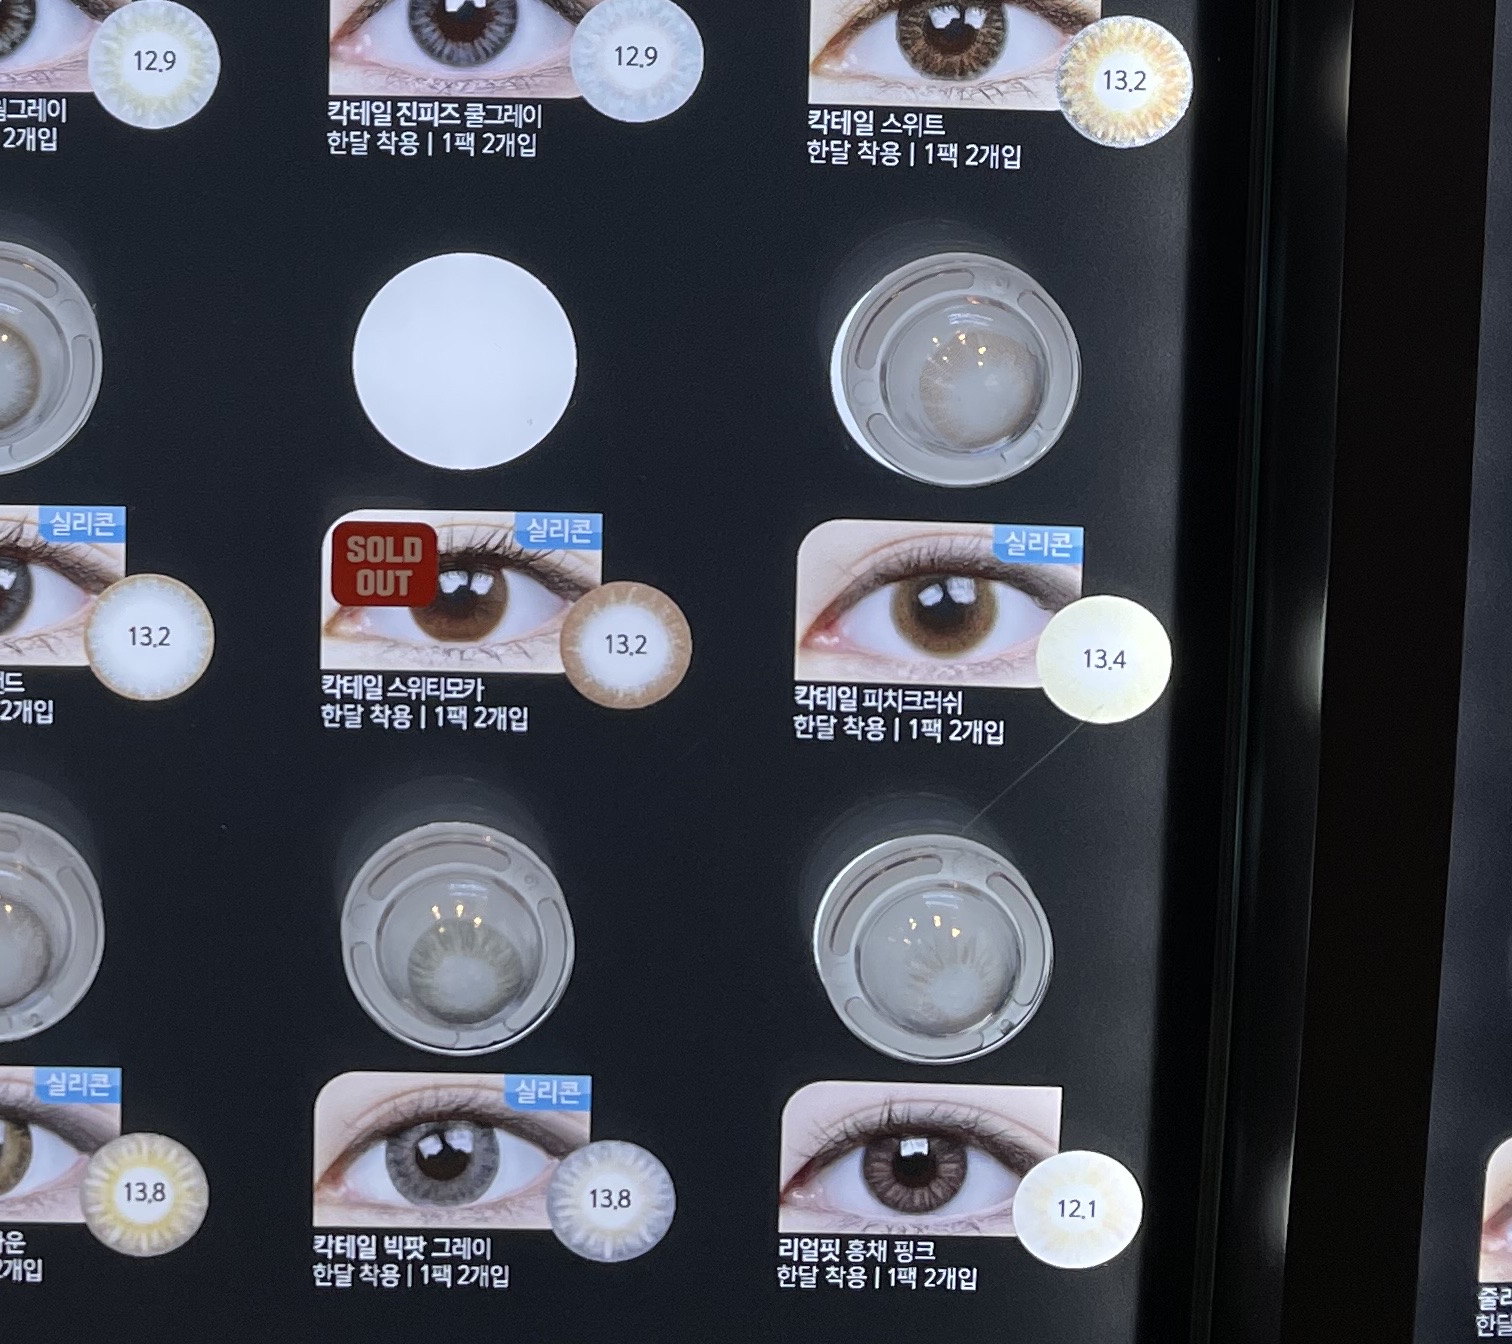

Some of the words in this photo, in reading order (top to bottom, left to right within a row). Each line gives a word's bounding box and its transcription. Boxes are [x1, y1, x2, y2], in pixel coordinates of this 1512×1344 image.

[134, 50, 176, 73] 12.9
[615, 46, 658, 68] 12.9
[1103, 70, 1147, 93] 13.2
[328, 101, 392, 127] 칵테일
[396, 102, 461, 127] 진피즈
[464, 103, 542, 129] 쿨그레이
[808, 110, 874, 137] 칵테일
[880, 112, 945, 138] 스위트
[807, 140, 850, 166] 한달
[857, 141, 901, 167] 착용
[925, 143, 958, 168] 1팩
[965, 144, 1022, 170] 2개입
[50, 511, 116, 537] 실리콘
[527, 518, 592, 544] 실리콘
[347, 536, 422, 563] SOLD
[1005, 531, 1072, 557] 실리콘
[356, 569, 413, 597] OUT
[128, 626, 170, 648] 13.2
[606, 634, 647, 656] 13.2
[1083, 649, 1126, 670] 13.4
[321, 674, 383, 701] 칵테일
[388, 677, 485, 702] 스위티모카
[794, 685, 858, 712] 칵테일
[862, 688, 963, 715] 피치크러쉬
[0, 700, 54, 724] 2개입
[794, 715, 837, 741] 한달
[843, 716, 886, 742] 착용
[910, 718, 942, 743] 1팩
[950, 719, 1005, 746] 2개입
[47, 1073, 111, 1098] 실리콘
[516, 1079, 581, 1105] 실리콘
[124, 1182, 166, 1205] 13.8
[590, 1189, 631, 1210] 13.8
[1058, 1199, 1097, 1220] 12.1
[313, 1234, 377, 1261] 칵테일
[383, 1236, 426, 1261] 빅팟
[431, 1237, 492, 1261] 그레이
[779, 1238, 840, 1262] 리얼핏
[845, 1240, 887, 1263] 홍채
[894, 1241, 935, 1262] 핑크
[778, 1266, 819, 1289] 한달
[825, 1266, 867, 1289] 착용
[888, 1267, 917, 1290] 1팩
[924, 1268, 977, 1291] 2개입
